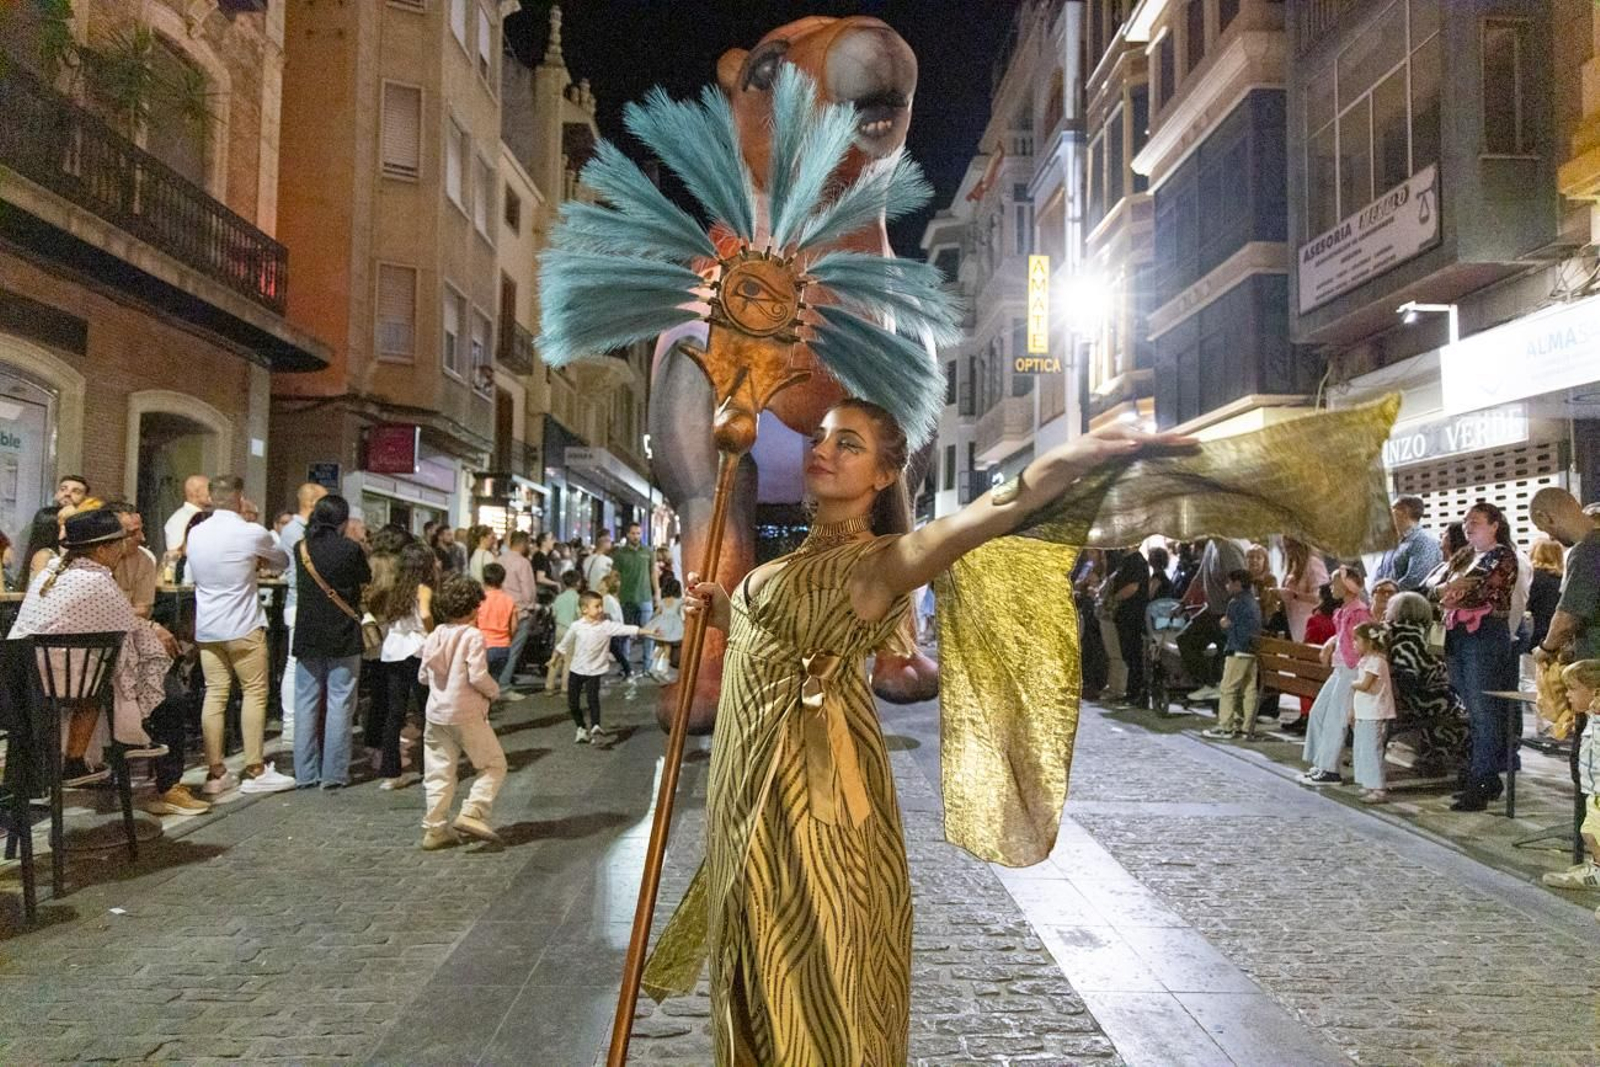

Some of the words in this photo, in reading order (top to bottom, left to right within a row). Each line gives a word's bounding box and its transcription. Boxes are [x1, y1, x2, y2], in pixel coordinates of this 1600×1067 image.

[1303, 222, 1352, 264] ASESORIA
[1031, 258, 1046, 349] AMATE
[1015, 357, 1062, 374] OPTICA
[0, 431, 21, 449] ble
[1387, 433, 1426, 465] NZO
[1445, 407, 1525, 452] VERDE
